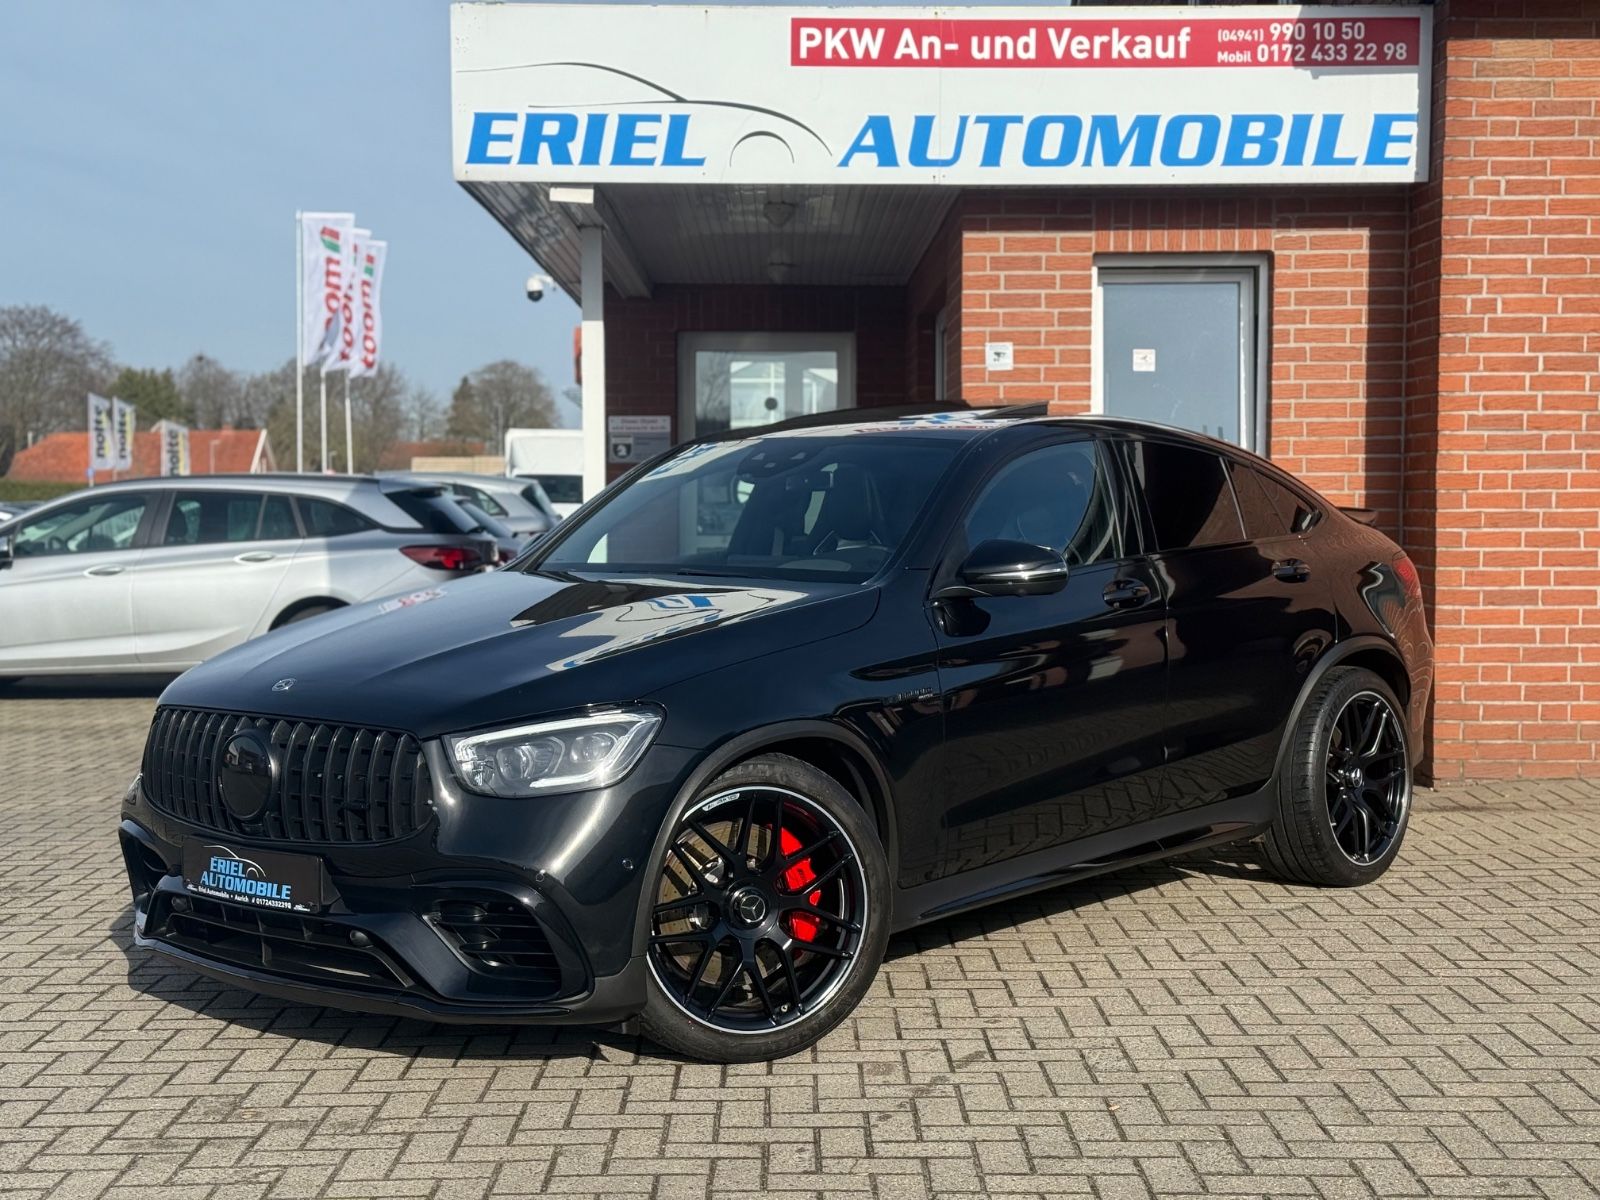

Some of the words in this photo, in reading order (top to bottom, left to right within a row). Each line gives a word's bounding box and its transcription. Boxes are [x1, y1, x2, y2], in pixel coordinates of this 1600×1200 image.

[799, 28, 887, 60] PKW
[894, 31, 960, 59] An-
[971, 28, 1045, 59] und
[1048, 27, 1192, 59] Verkauf
[1217, 28, 1265, 43] (04941)
[1269, 23, 1306, 41] 990
[1313, 22, 1336, 40] 10
[1341, 22, 1366, 40] 50
[1217, 50, 1253, 63] Mobil
[1256, 44, 1306, 63] 0172
[1311, 43, 1348, 62] 433
[1353, 43, 1378, 61] 22
[1383, 43, 1408, 60] 98
[465, 111, 707, 167] ERIEL
[837, 113, 1419, 168] AUTOMOBILE
[321, 256, 342, 336] om
[361, 279, 377, 368] toom
[209, 856, 246, 878] ERIEL
[200, 871, 292, 900] AUTOMOBILE
